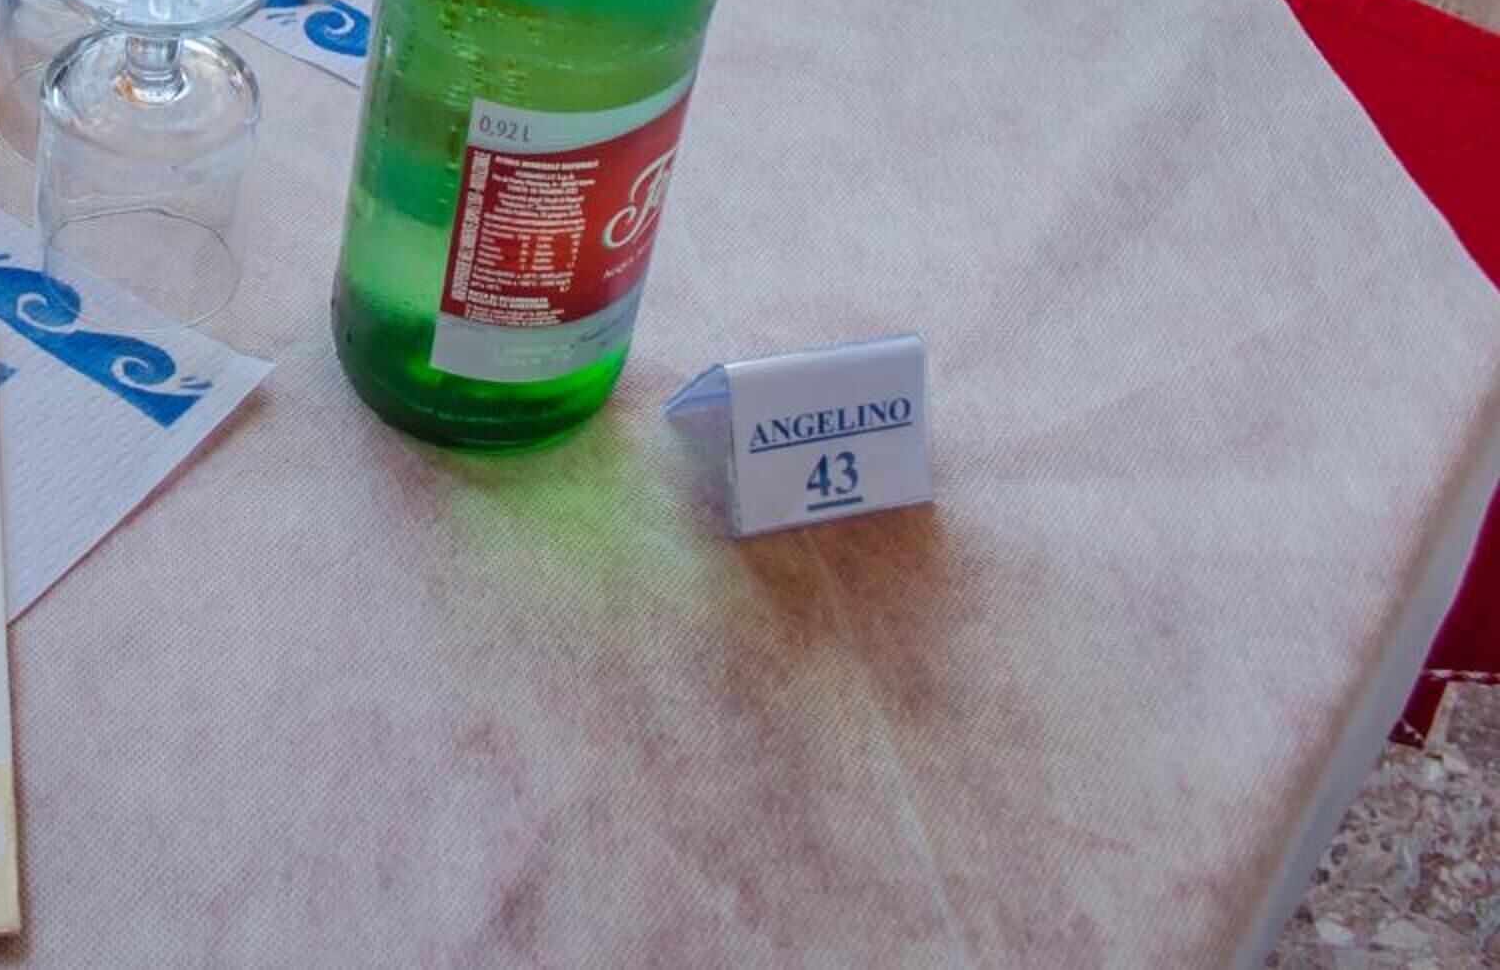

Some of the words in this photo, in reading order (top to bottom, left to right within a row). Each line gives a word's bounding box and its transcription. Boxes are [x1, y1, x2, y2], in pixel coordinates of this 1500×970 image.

[479, 115, 518, 142] 0,92
[751, 397, 911, 446] ANGELINO
[806, 451, 859, 497] 43
